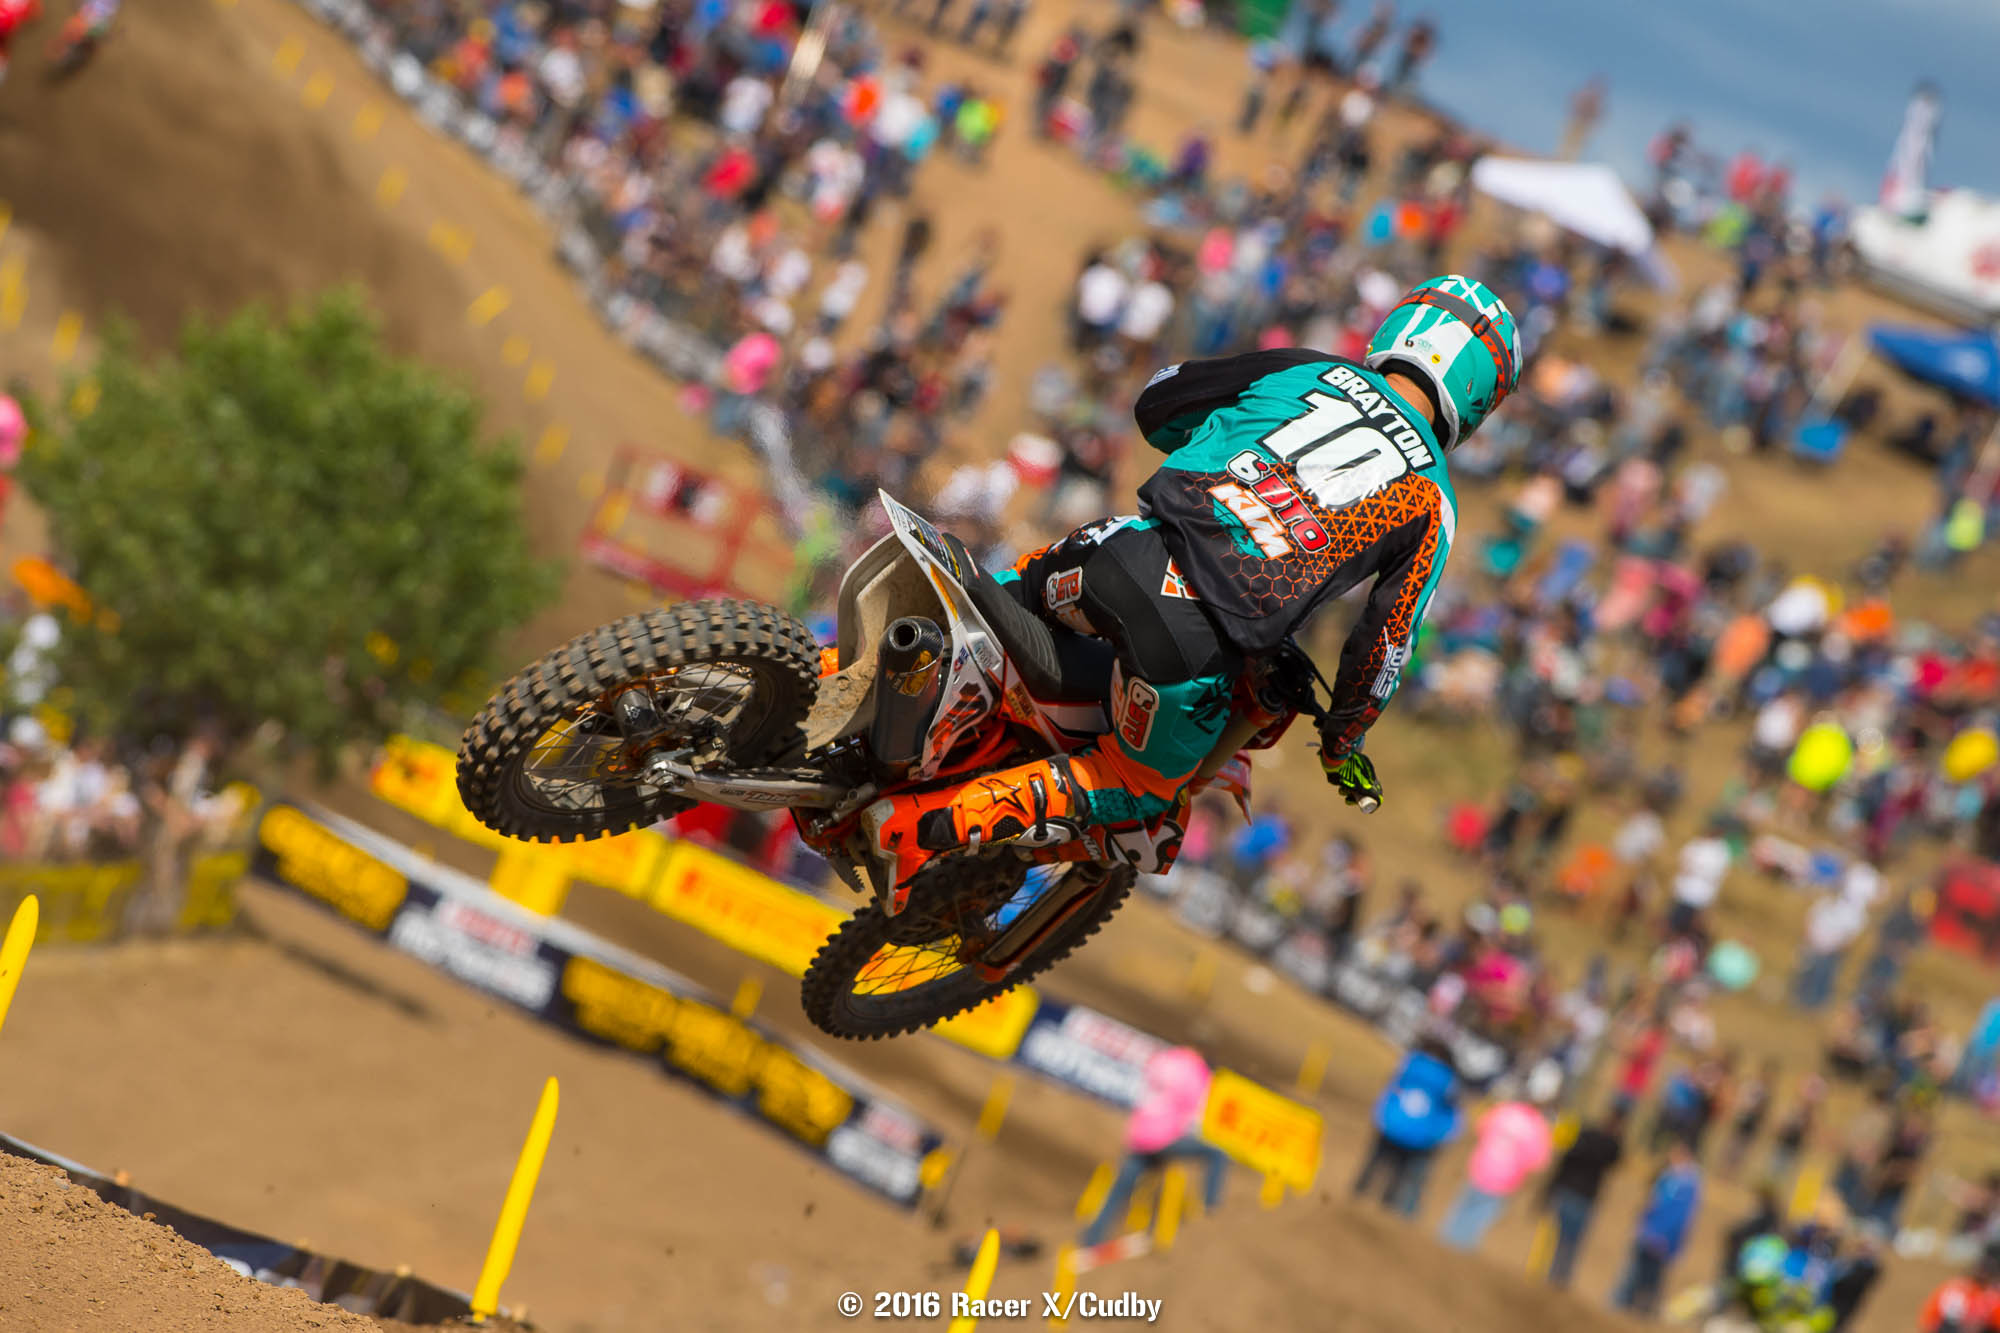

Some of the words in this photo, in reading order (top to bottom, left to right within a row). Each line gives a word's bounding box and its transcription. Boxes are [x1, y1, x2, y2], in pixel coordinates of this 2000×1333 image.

[1261, 390, 1408, 507] 10
[1320, 364, 1434, 470] BRAYTON
[1208, 481, 1294, 560] KTM
[1376, 647, 1404, 698] WPS
